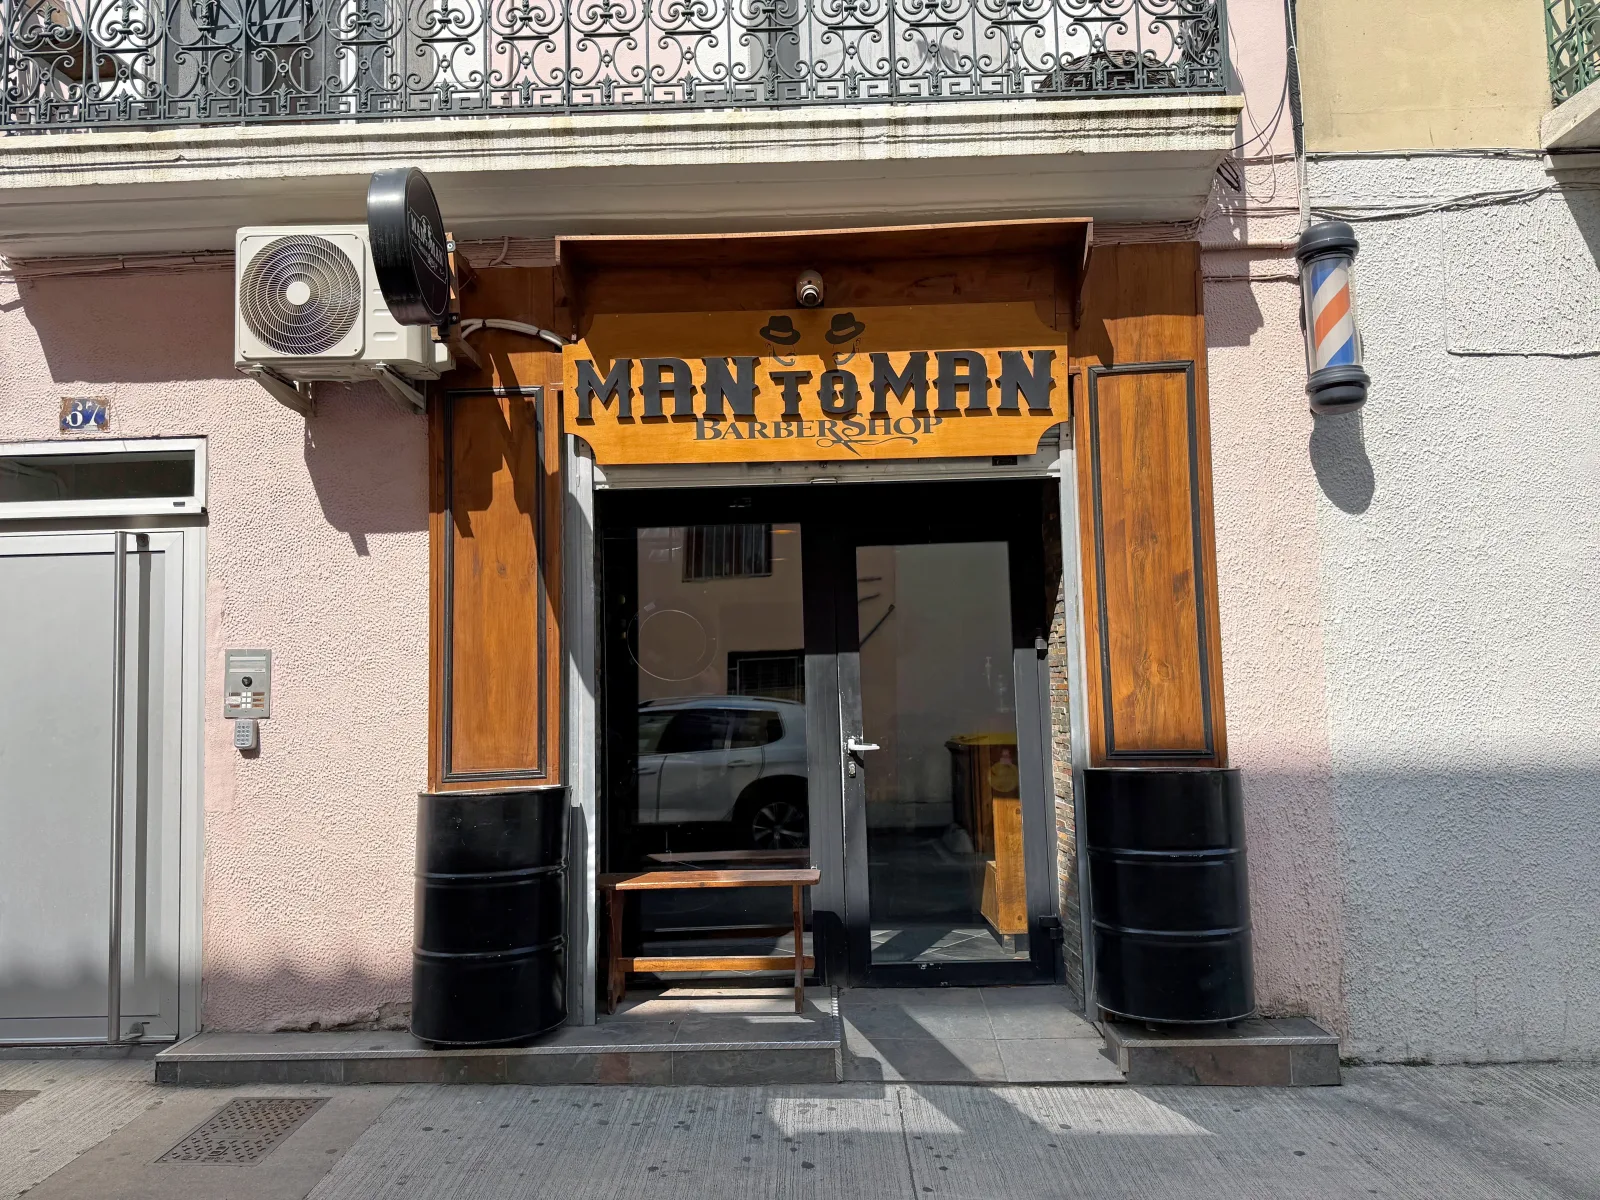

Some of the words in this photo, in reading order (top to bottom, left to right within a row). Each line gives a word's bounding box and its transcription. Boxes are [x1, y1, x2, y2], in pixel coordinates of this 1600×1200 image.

[575, 357, 761, 424] MAN
[769, 370, 862, 420] TO
[869, 350, 1057, 419] MAN
